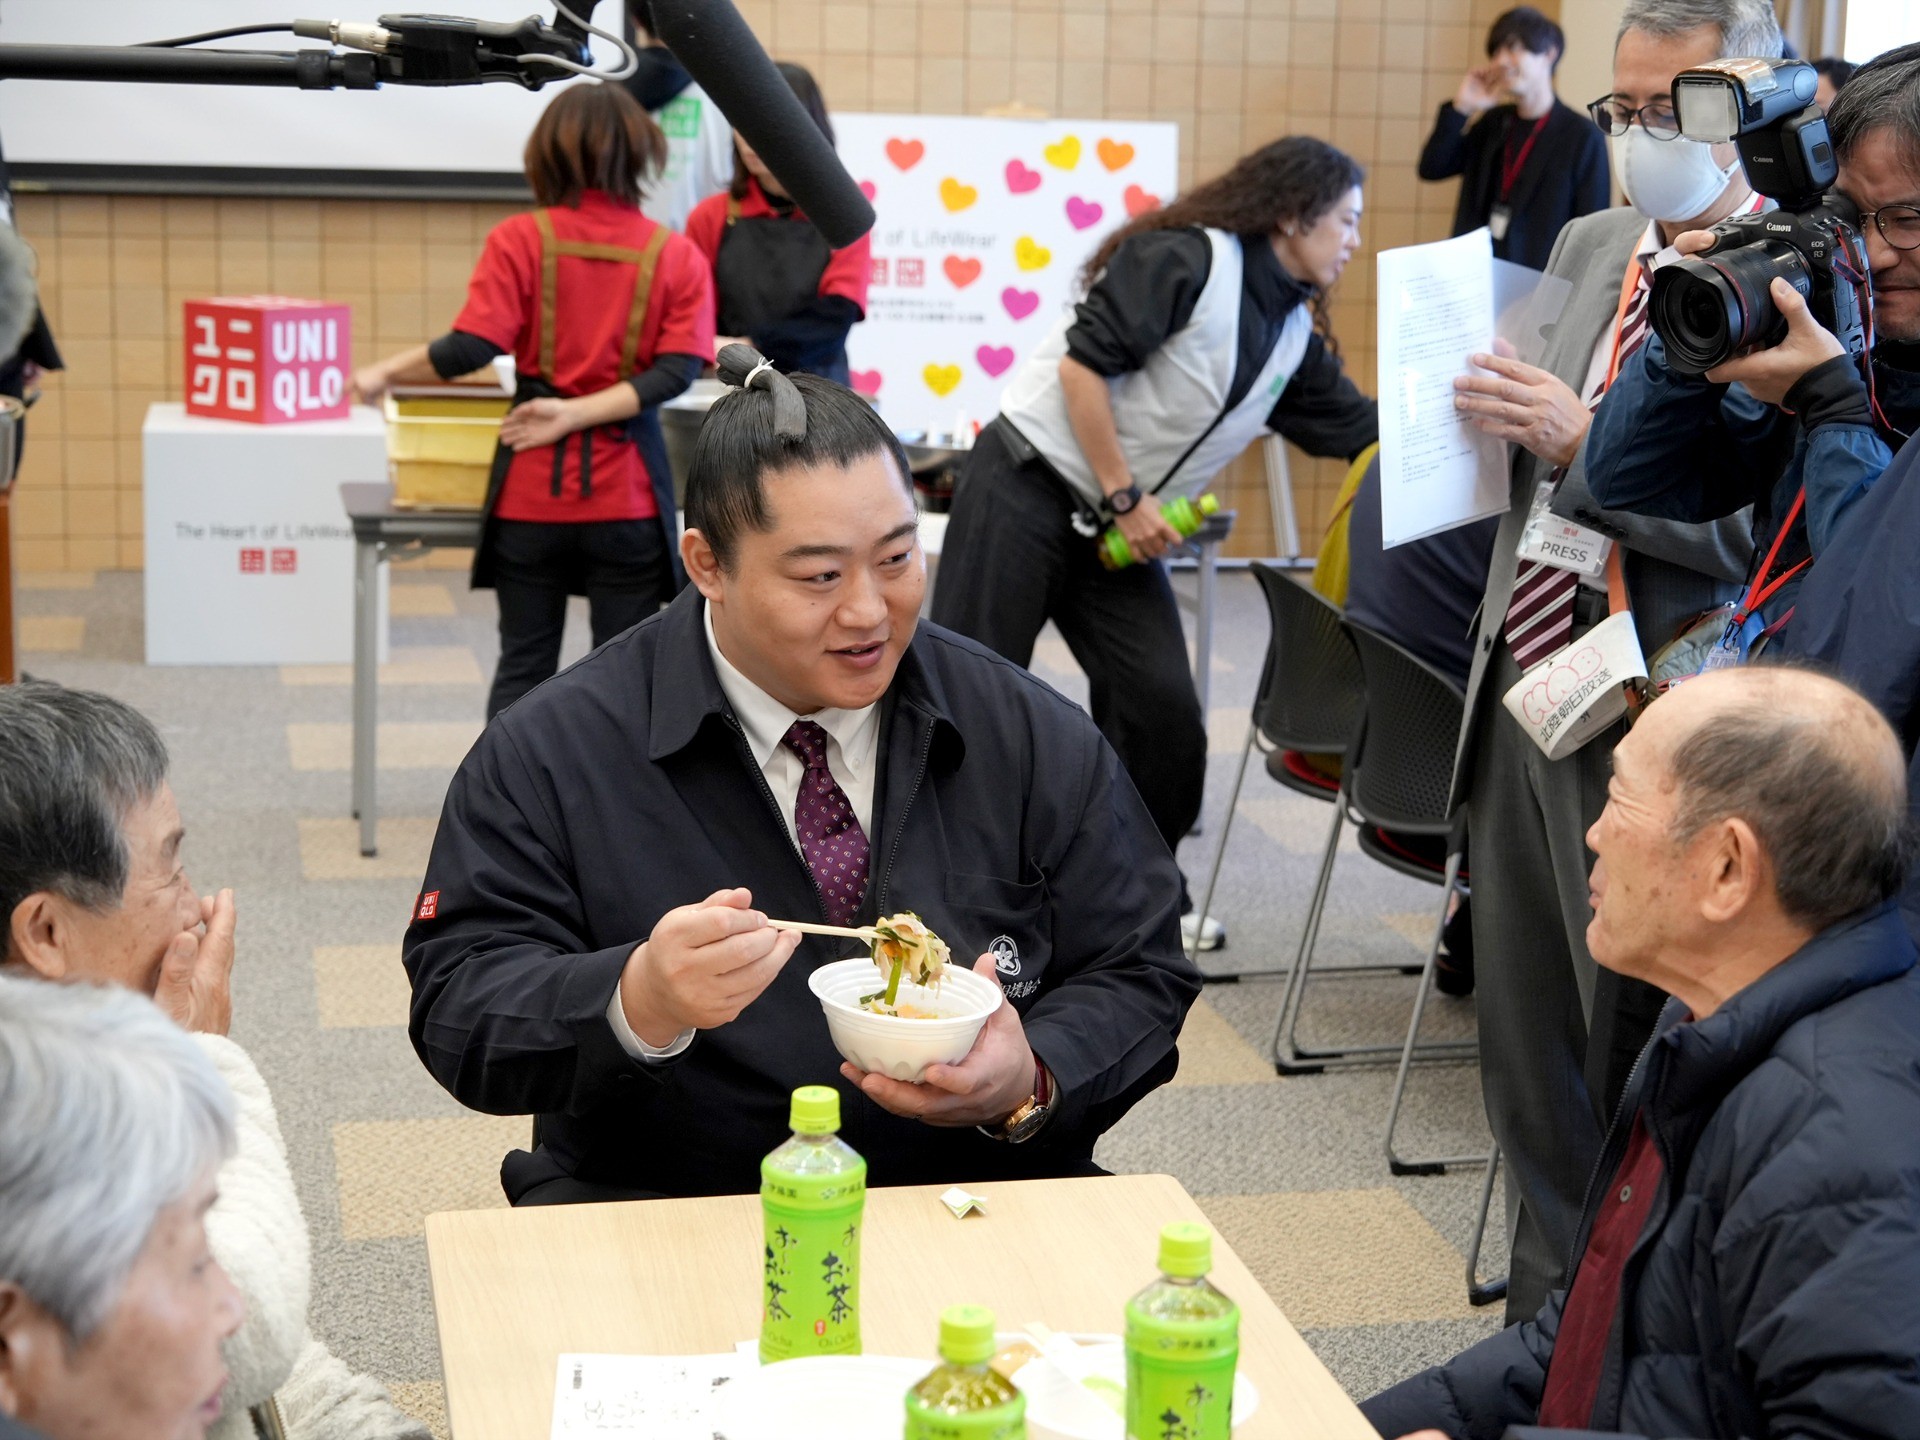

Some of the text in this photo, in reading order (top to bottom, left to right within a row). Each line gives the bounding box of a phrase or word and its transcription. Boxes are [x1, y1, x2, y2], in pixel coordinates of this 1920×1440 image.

[1752, 155, 1774, 164] Canon
[1766, 222, 1792, 233] Canon
[1811, 240, 1824, 248] EOS
[1813, 249, 1823, 258] R3
[192, 315, 255, 362] ユニ
[272, 319, 337, 363] UNI
[191, 364, 255, 411] クロ
[272, 366, 343, 418] QLO
[176, 521, 354, 541] The Heart of LifeWea
[1540, 541, 1588, 563] PRESS
[1539, 667, 1613, 744] 北陸朝日放送
[424, 895, 435, 905] UNI
[420, 905, 434, 917] QLO
[821, 1251, 854, 1326] お茶
